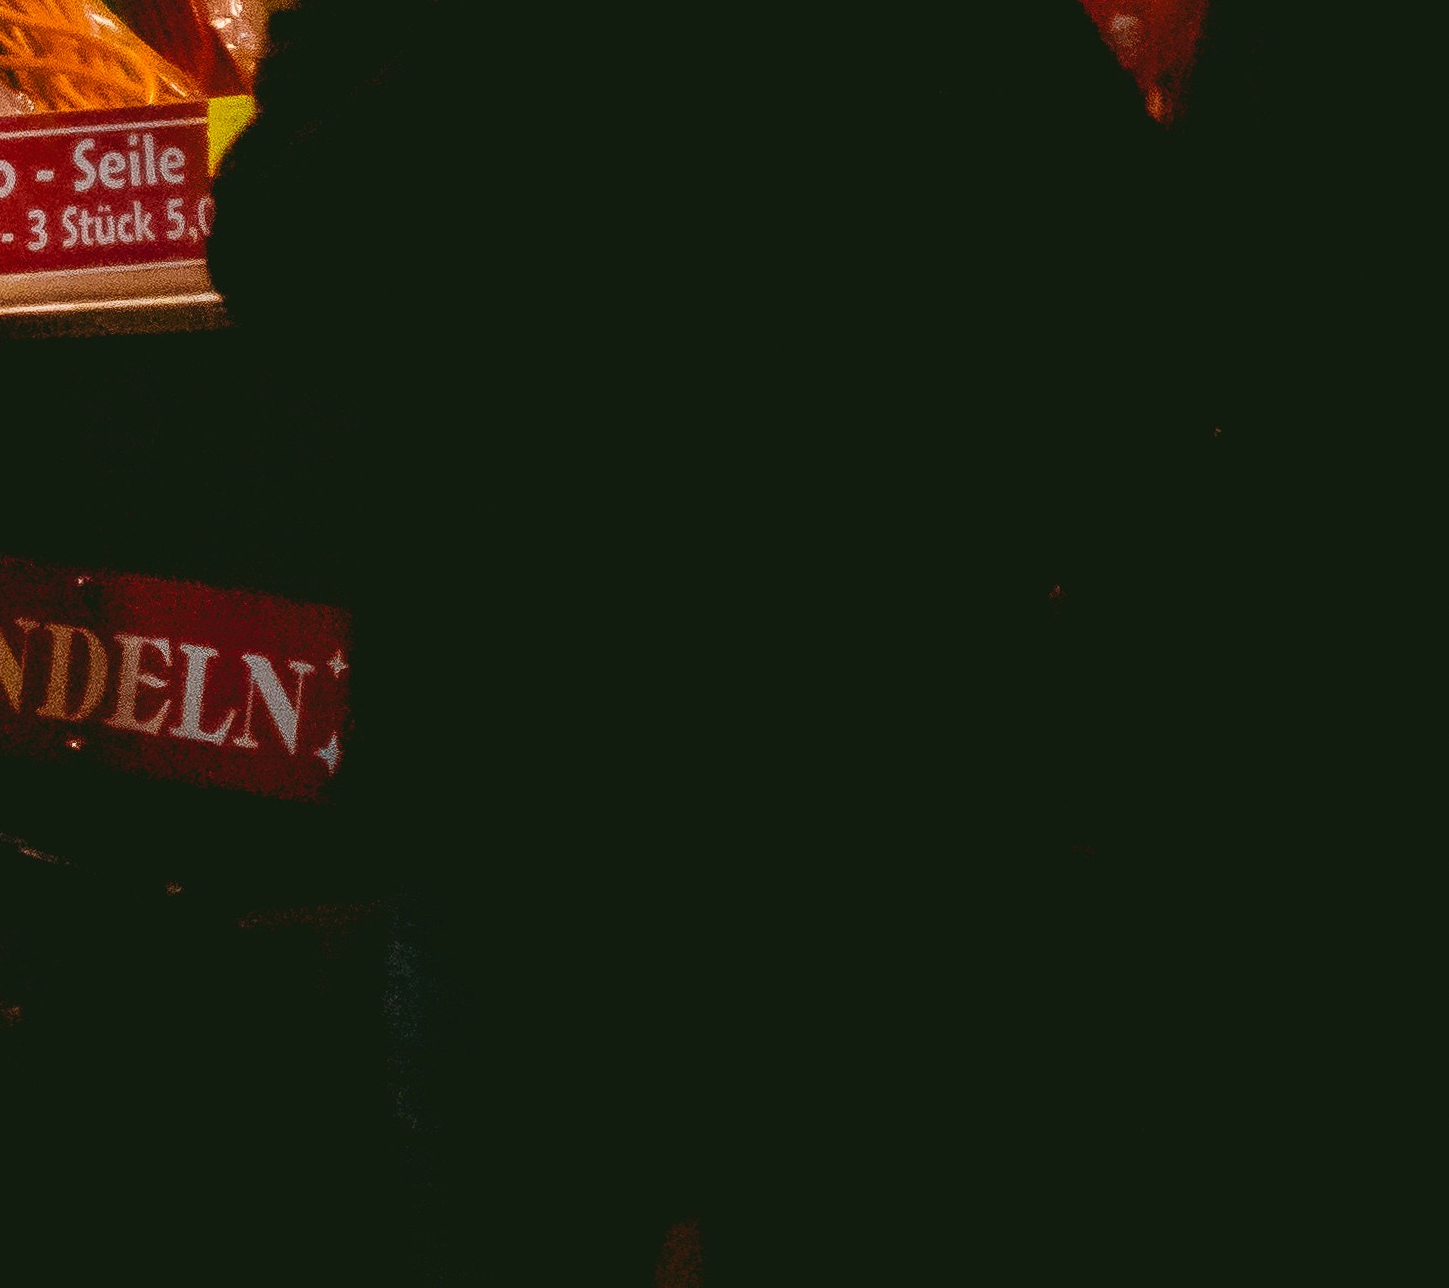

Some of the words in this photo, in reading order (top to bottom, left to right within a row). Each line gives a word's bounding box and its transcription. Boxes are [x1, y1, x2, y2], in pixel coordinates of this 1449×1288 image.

[73, 134, 186, 193] Seile
[27, 209, 48, 251] 3
[62, 202, 153, 249] Stück
